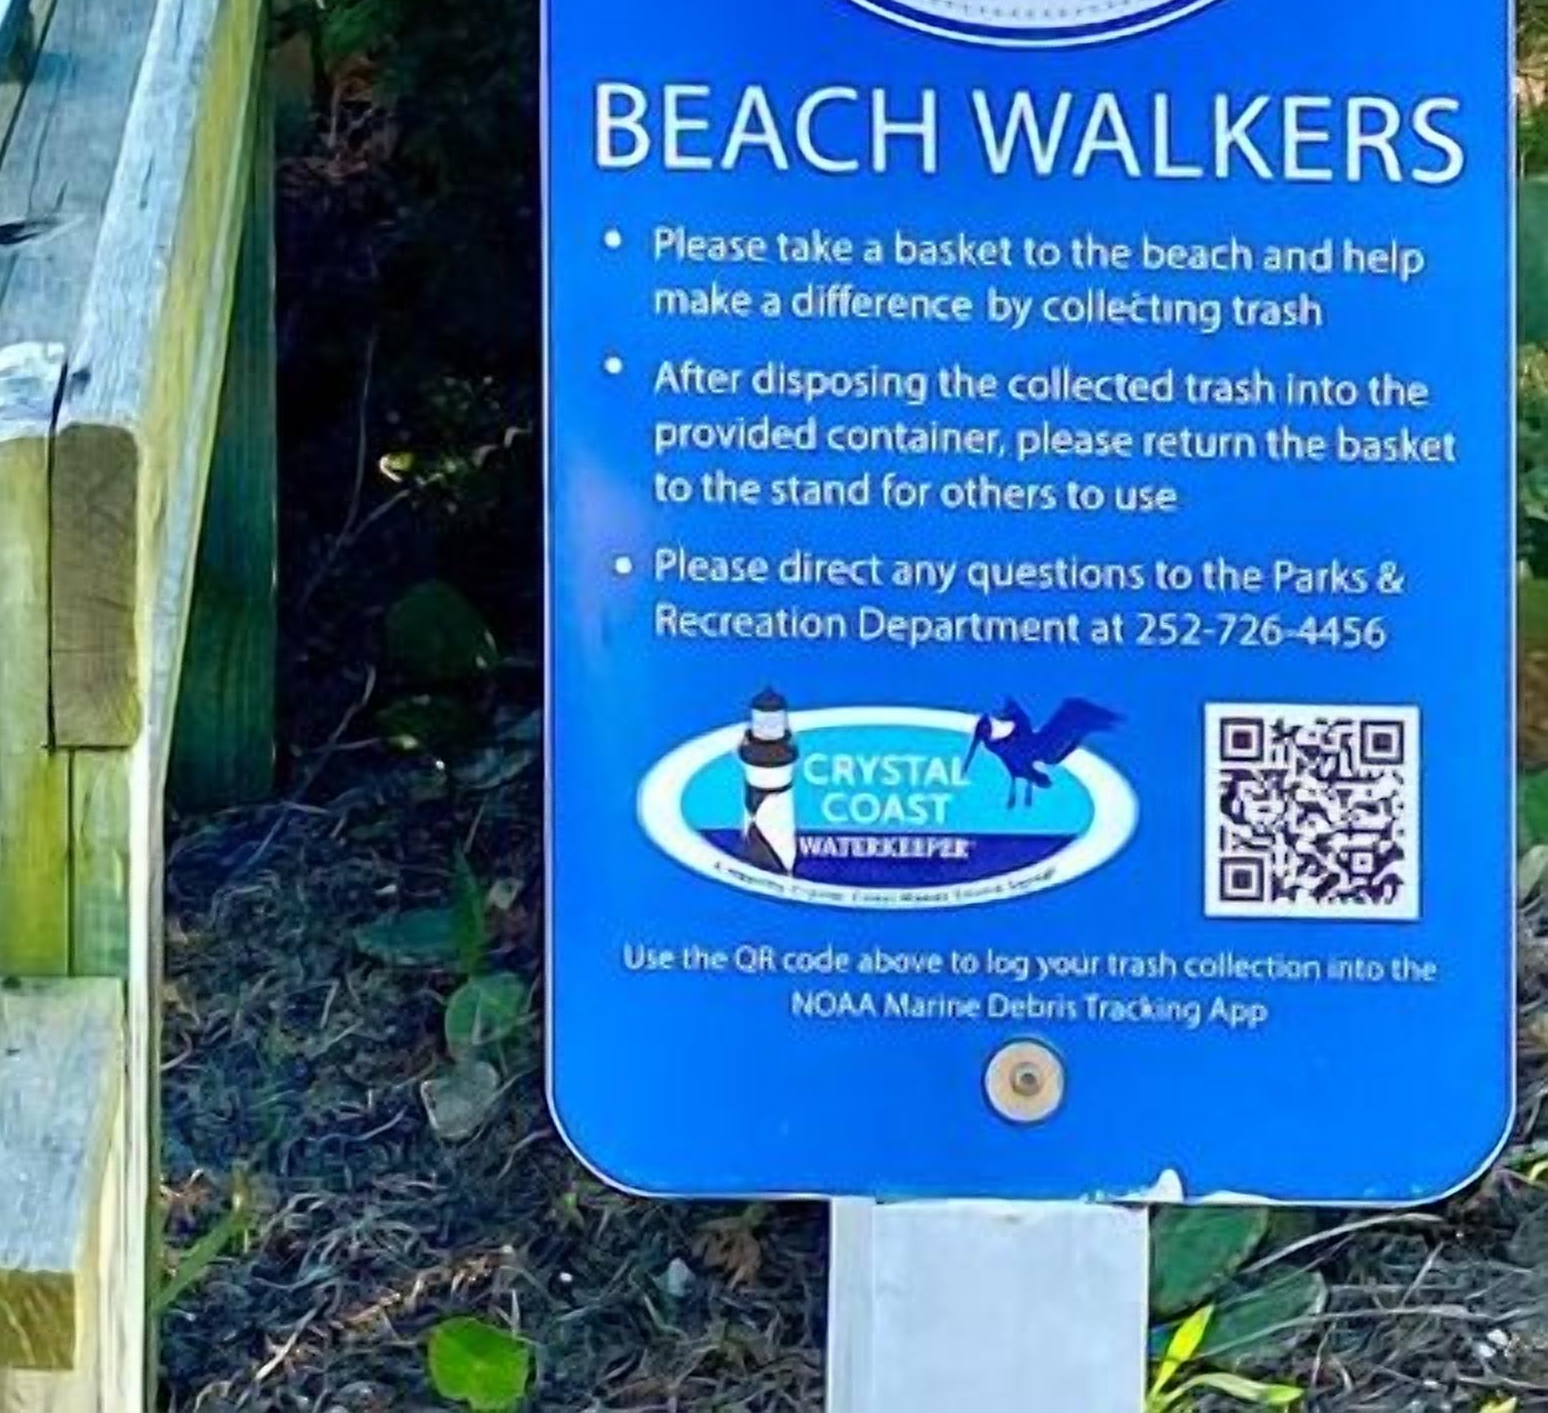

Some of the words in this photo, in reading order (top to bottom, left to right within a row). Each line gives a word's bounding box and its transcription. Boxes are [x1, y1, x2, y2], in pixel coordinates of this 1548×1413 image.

[597, 83, 935, 172] BEACH
[973, 91, 1463, 183] WALKERS
[654, 226, 767, 261] Please
[777, 229, 853, 263] take
[864, 240, 883, 263] a
[895, 230, 1012, 266] basket
[1024, 238, 1061, 267] to
[1071, 233, 1132, 269] the
[1143, 235, 1252, 270] beach
[1264, 239, 1333, 273] and
[1343, 239, 1424, 282] help
[655, 283, 752, 317] make
[760, 292, 781, 317] a
[792, 283, 973, 321] difference
[988, 287, 1032, 329] by
[1042, 288, 1221, 333] collecting
[1232, 293, 1322, 326] trash
[655, 360, 742, 393] After
[752, 362, 928, 405] disposing
[938, 364, 998, 398] the
[1008, 366, 1173, 402] collected
[1185, 370, 1275, 404] trash
[1288, 373, 1359, 405] into
[1368, 373, 1428, 406] the
[655, 417, 817, 454] provided
[827, 421, 1004, 456] container,
[1017, 422, 1133, 461] please
[1144, 428, 1256, 457] return
[1266, 426, 1328, 460] the
[1337, 427, 1455, 461] basket
[655, 473, 692, 502] to
[701, 472, 761, 504] the
[772, 474, 870, 505] stand
[882, 474, 931, 507] for
[940, 476, 1056, 509] others
[1067, 482, 1104, 509] to
[1116, 486, 1177, 511] use
[655, 547, 768, 583] Please
[778, 549, 883, 585] direct
[892, 561, 956, 593] any
[967, 557, 1144, 594] questions
[1156, 561, 1192, 589] to
[1203, 557, 1264, 591] the
[1274, 560, 1368, 593] Parks
[1376, 561, 1404, 593] &
[656, 603, 847, 638] Recreation
[859, 606, 1079, 648] Department
[1091, 614, 1123, 644] at
[1137, 613, 1386, 649] 252-726-4456
[804, 753, 969, 787] CRYSTAL
[822, 793, 950, 827] COAST
[624, 944, 676, 969] Use
[682, 945, 728, 970] the
[733, 945, 776, 973] QR
[782, 946, 850, 973] code
[857, 948, 943, 973] above
[951, 951, 980, 974] to
[986, 949, 1030, 981] log
[1036, 955, 1100, 981] your
[1108, 951, 1177, 978] trash
[1184, 952, 1320, 979] collection
[1327, 958, 1384, 981] into
[1392, 956, 1437, 981] the
[792, 991, 876, 1017] NOAA
[884, 993, 980, 1018] Marine
[988, 993, 1077, 1019] Debris
[1084, 995, 1201, 1028] Tracking
[1208, 997, 1268, 1028] App
